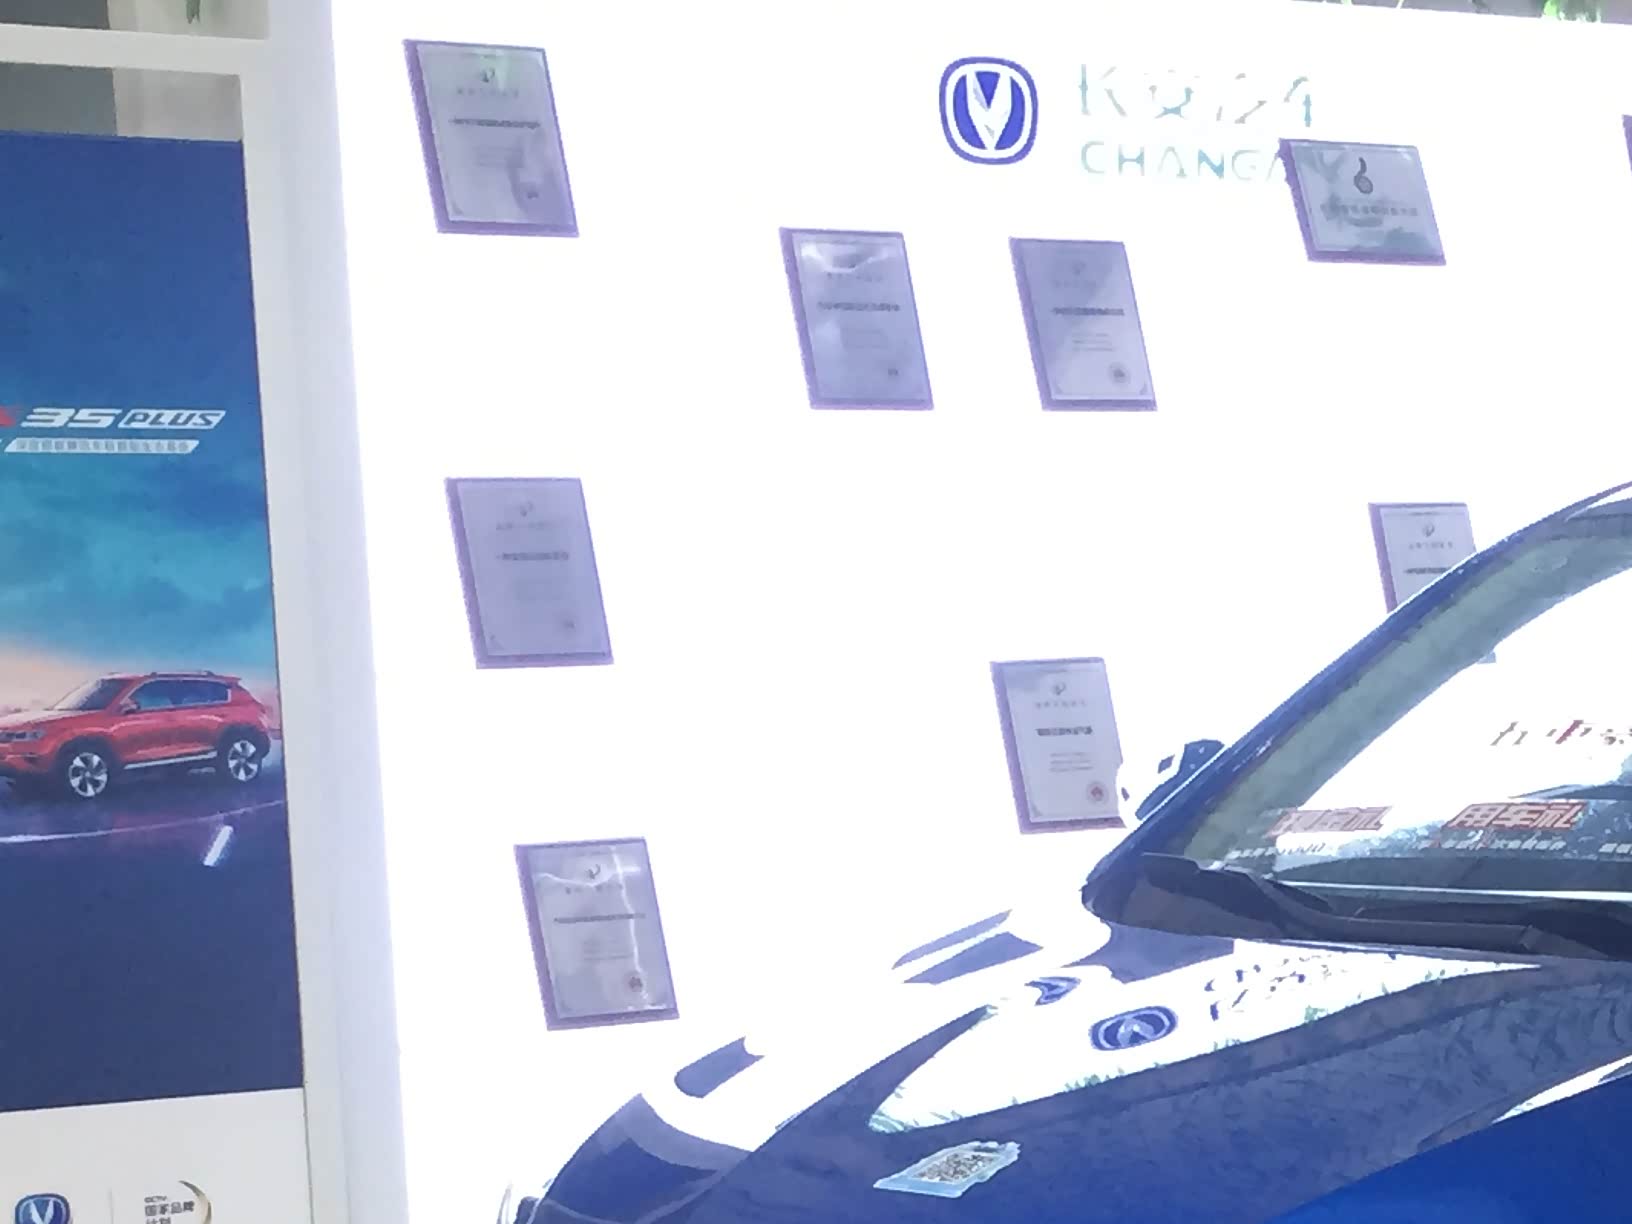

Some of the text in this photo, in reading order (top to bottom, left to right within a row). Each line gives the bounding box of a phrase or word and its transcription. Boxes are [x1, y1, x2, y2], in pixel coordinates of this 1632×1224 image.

[1080, 140, 1281, 183] CHANG
[122, 409, 216, 428] PLUS
[1444, 803, 1585, 830] 用车礼
